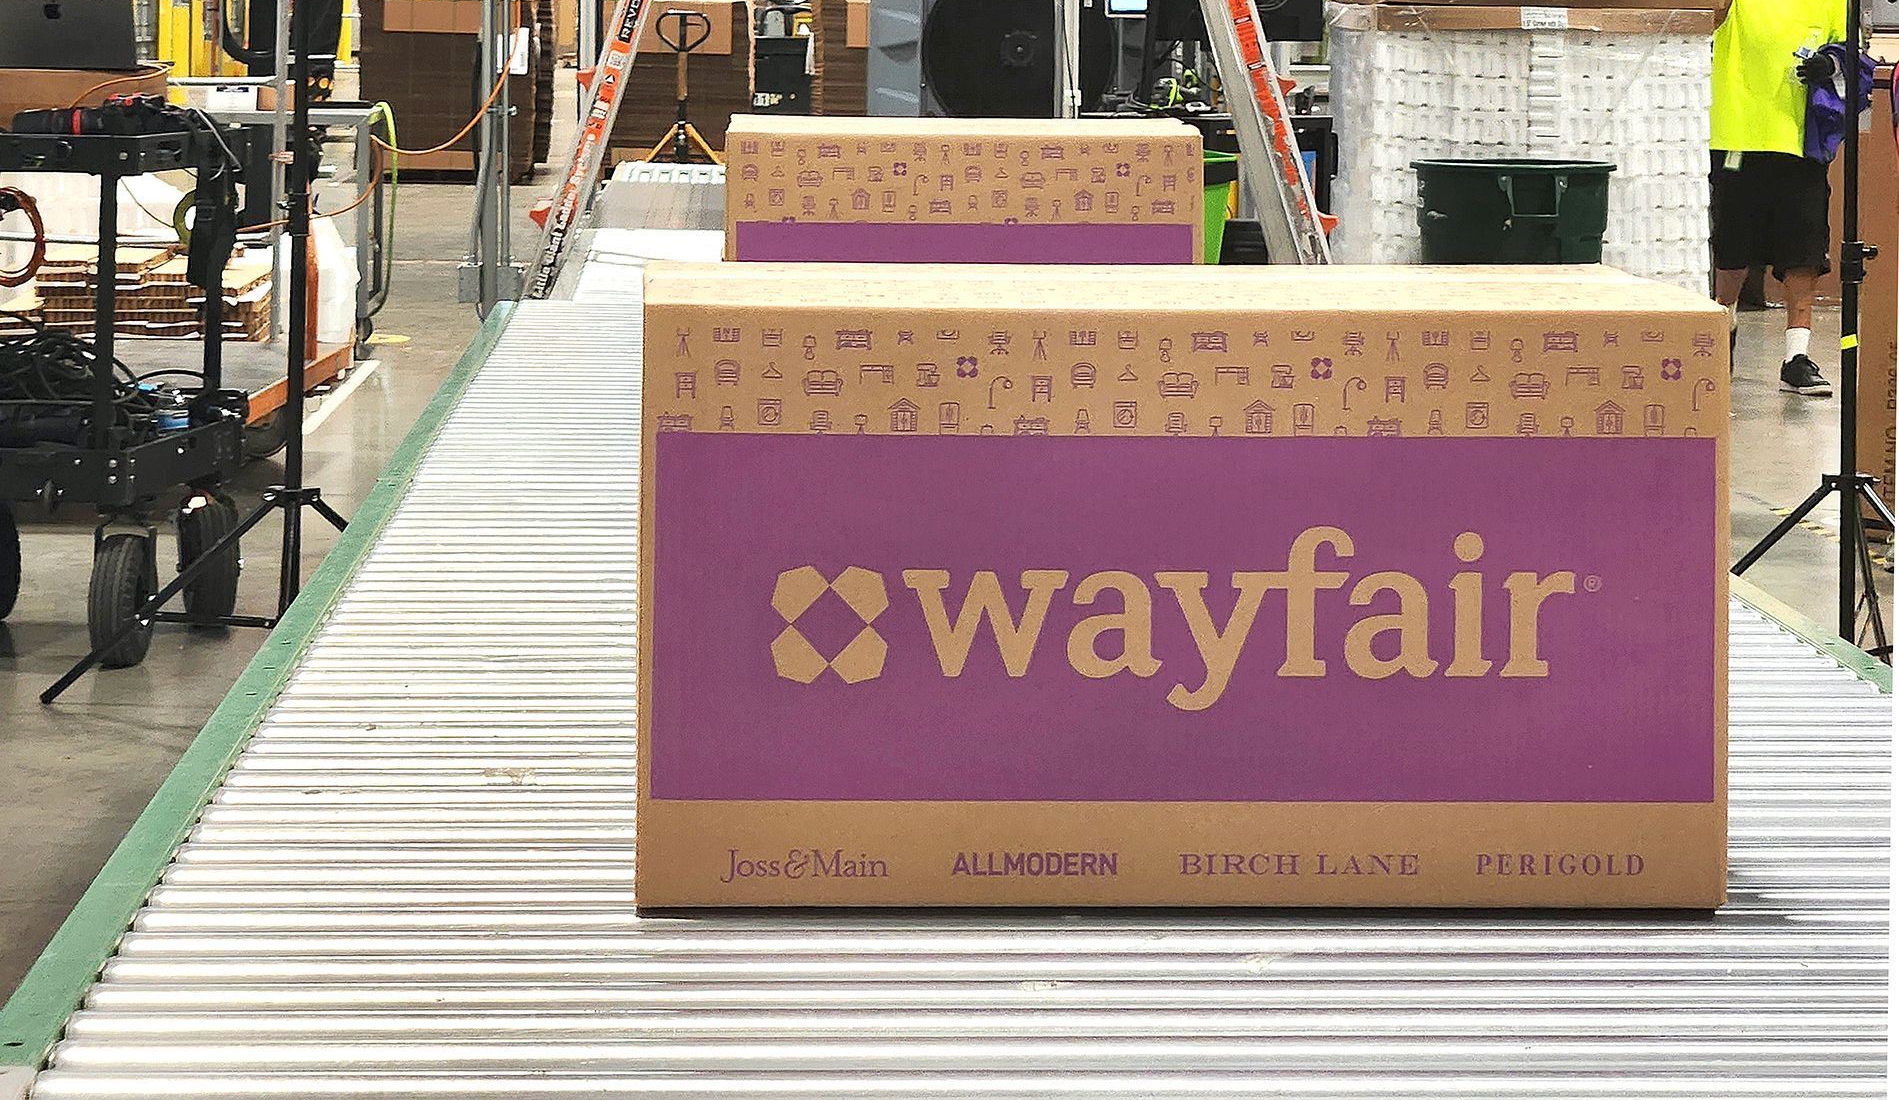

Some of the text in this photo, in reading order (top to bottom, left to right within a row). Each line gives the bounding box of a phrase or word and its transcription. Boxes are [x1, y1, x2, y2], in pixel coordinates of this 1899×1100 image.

[952, 851, 1118, 877] ALLMODERN
[1178, 853, 1420, 876] BIRCH LANE
[1475, 853, 1645, 876] PERIGOLD
